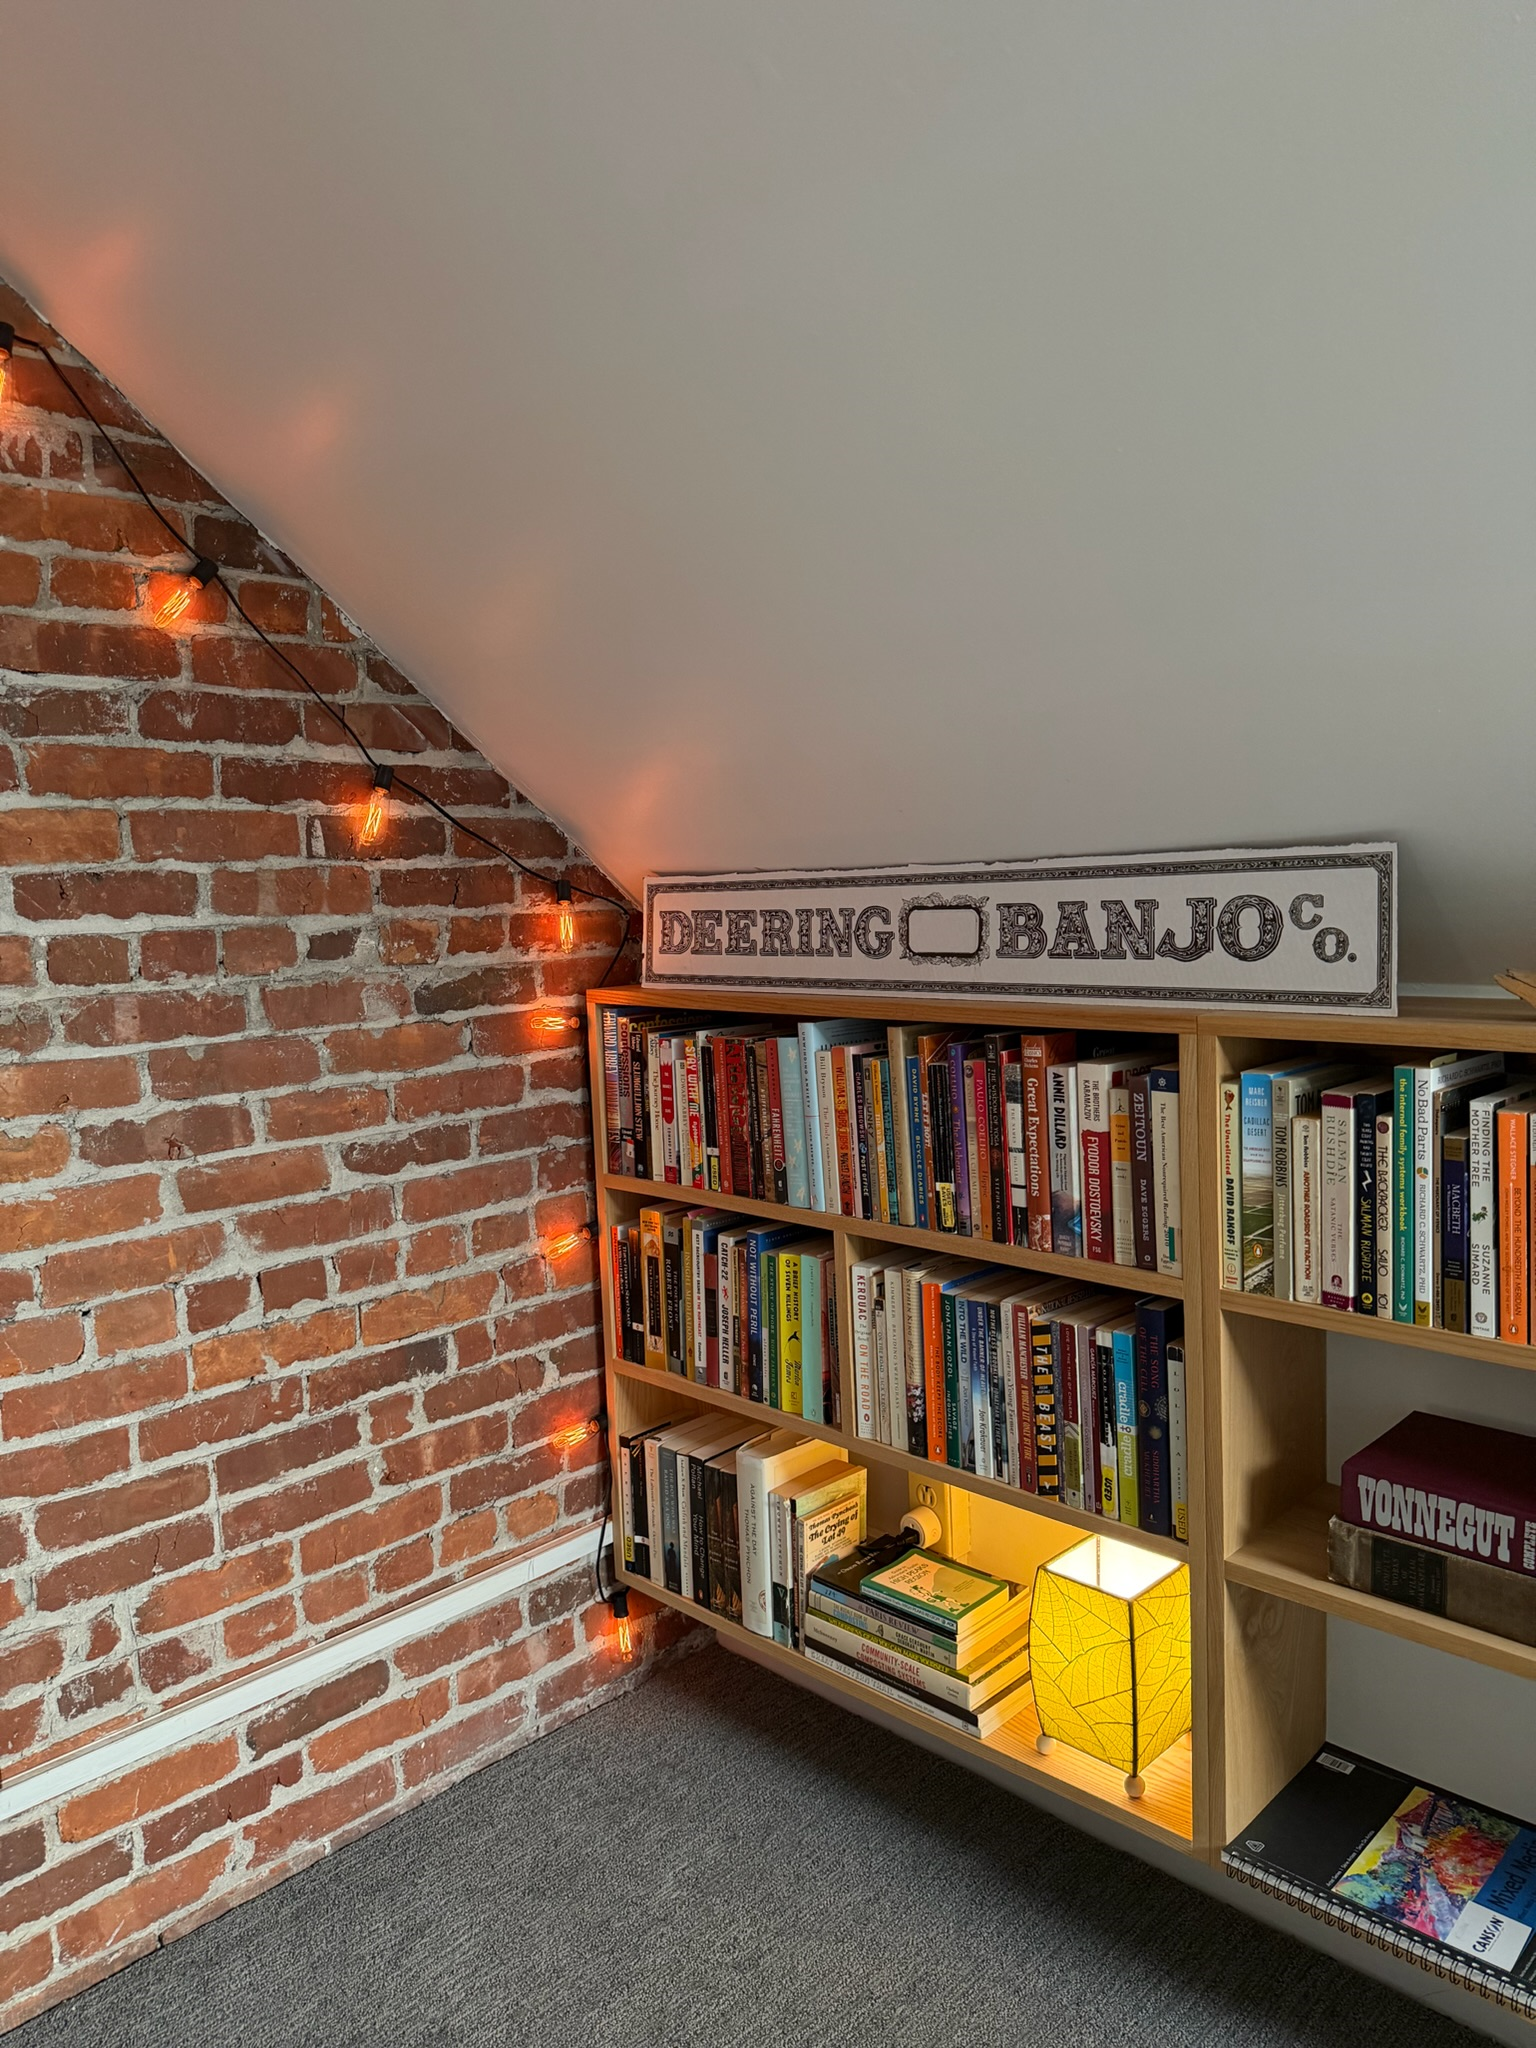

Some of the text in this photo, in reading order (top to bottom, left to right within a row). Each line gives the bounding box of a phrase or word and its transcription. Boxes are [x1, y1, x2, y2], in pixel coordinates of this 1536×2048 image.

[658, 908, 892, 958] DEERING
[996, 895, 1283, 962] BANJO
[621, 1023, 630, 1097] confessions
[686, 1046, 696, 1071] STAY
[632, 1062, 643, 1141] SLUMGULLION STEW
[688, 1074, 697, 1099] WITH
[1083, 1080, 1091, 1121] KARAMAZOV
[689, 1103, 699, 1117] ME
[771, 1108, 782, 1157] FAHRENHEIT
[976, 1079, 986, 1160] PAULO COELHO
[1053, 1072, 1067, 1150] ANNIE DILLARD
[1244, 1117, 1270, 1126] CADILLAC
[1418, 1079, 1428, 1160] No Bad Parts
[1027, 1077, 1042, 1197] Great Expectations
[1275, 1126, 1288, 1188] TOM ROBBINS
[1326, 1115, 1337, 1186] RUSHDIE
[1337, 1119, 1347, 1184] SALMAN
[1398, 1078, 1407, 1232] the internal family systems workbook
[1471, 1109, 1480, 1188] MOTHER TREE
[1481, 1109, 1490, 1182] FINDING THE
[954, 1138, 962, 1184] Alchemist
[1133, 1093, 1147, 1162] ZEITOUN
[1141, 1206, 1149, 1241] EGGERS
[1087, 1136, 1102, 1242] FYODOR DOSTOEVSKY
[1226, 1178, 1235, 1207] DAVID
[1451, 1184, 1461, 1234] MACBETH
[1513, 1187, 1522, 1217] BEYOND
[749, 1239, 757, 1259] NOT
[1227, 1208, 1236, 1245] RAKOFF
[1277, 1193, 1287, 1260] Jitterbug Perfume
[1360, 1196, 1372, 1283] SALMAN RUSHDIE
[785, 1259, 791, 1268] OF
[1471, 1243, 1480, 1286] SIMARD
[1482, 1244, 1490, 1295] SUZANNE
[1514, 1236, 1522, 1280] HUNDREDTH
[958, 1301, 966, 1321] INTO
[1514, 1282, 1522, 1316] MERIDIAN
[857, 1275, 870, 1410] KEROUAC ON THE ROAD
[1150, 1335, 1159, 1389] THE SONG
[1036, 1347, 1052, 1452] THE BEAST
[1118, 1382, 1129, 1423] cradle
[979, 1423, 988, 1453] Krakauer
[1152, 1449, 1160, 1504] SIDDHARTHA
[809, 1517, 831, 1530] Thomas
[809, 1509, 859, 1542] The Crying of
[822, 1526, 846, 1545] Lot 49
[1177, 1507, 1186, 1534] USED
[1357, 1474, 1516, 1563] VONNEGUT
[865, 1606, 888, 1622] PARIS
[888, 1612, 919, 1634] REVIEW
[811, 1651, 834, 1667] GREAT
[836, 1662, 871, 1684] WESTERN
[871, 1679, 894, 1696] TRAIL
[856, 1651, 896, 1676] COMPOSTING
[899, 1669, 926, 1690] SYSTEMS
[861, 1643, 920, 1677] COMMUNITY-SCALE
[1486, 1871, 1527, 1911] Mixed
[1472, 1915, 1505, 1953] CANSON
